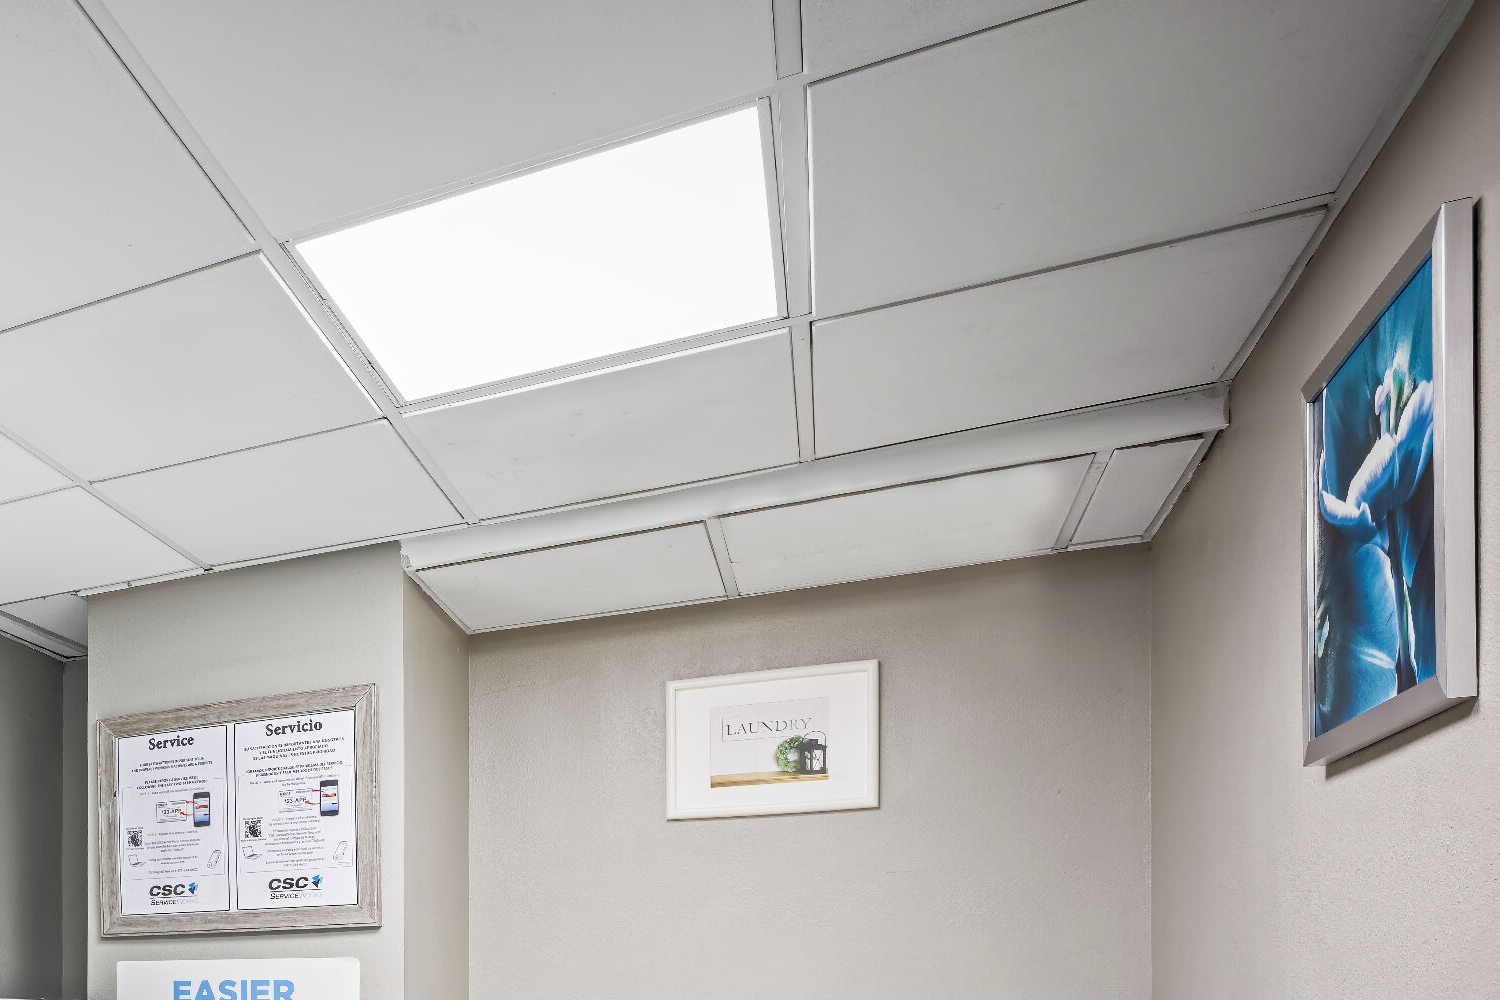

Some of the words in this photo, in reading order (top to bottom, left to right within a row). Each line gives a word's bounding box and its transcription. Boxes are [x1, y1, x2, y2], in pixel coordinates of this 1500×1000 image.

[265, 718, 323, 737] Servicio
[726, 717, 812, 736] LAUNDRY
[148, 734, 195, 751] Service
[149, 883, 186, 897] CSC
[268, 876, 309, 890] CSC
